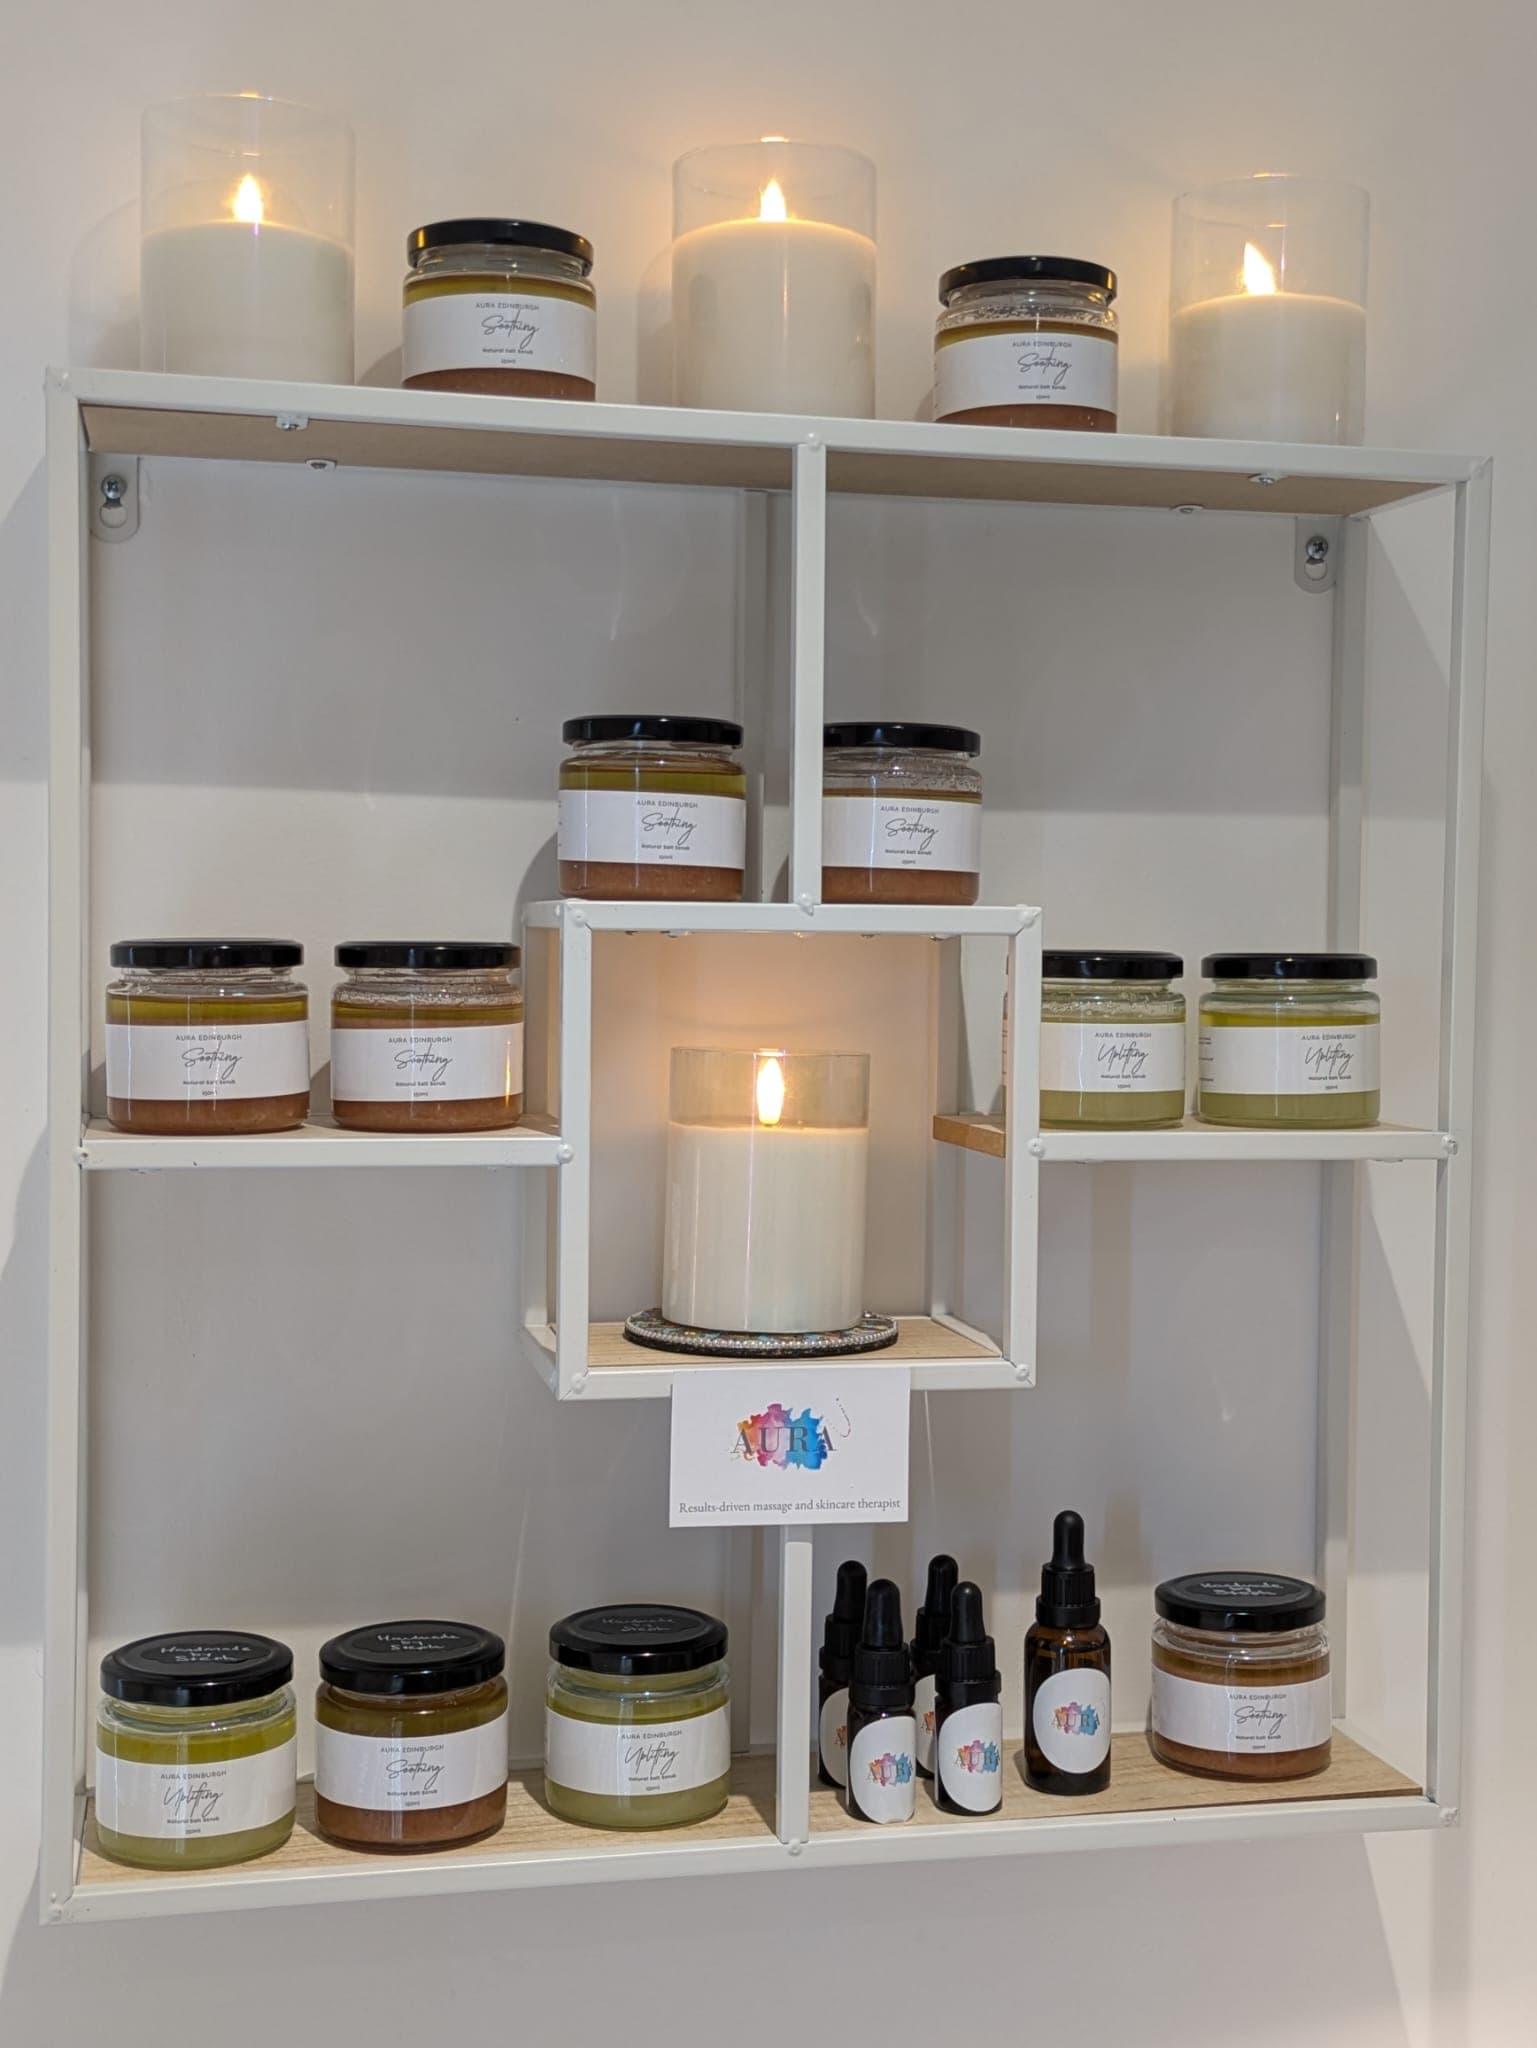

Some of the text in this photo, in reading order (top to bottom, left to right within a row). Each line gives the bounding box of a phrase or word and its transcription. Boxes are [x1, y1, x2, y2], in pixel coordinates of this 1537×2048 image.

[497, 302, 540, 311] EDINBURGH
[481, 309, 540, 350] Soothing
[1033, 340, 1072, 348] EDINBURGH
[1017, 347, 1072, 386] Soothing
[657, 800, 698, 809] EDINBURGH
[901, 806, 939, 814] EDINBURGH
[641, 807, 698, 846] Soothing
[885, 813, 940, 851] Soothing
[198, 1033, 242, 1041] EDINBURGH
[1322, 1033, 1356, 1041] EDINBURGH
[181, 1039, 243, 1081] Soothing
[394, 1041, 453, 1082] Soothing
[1097, 1040, 1150, 1075] Uplifting
[1304, 1042, 1354, 1076] Uplifting
[731, 1426, 837, 1454] AURA
[679, 1497, 901, 1514] Results-driven massage and skincare therapist
[1249, 1693, 1287, 1701] EDINBURGH
[1050, 1711, 1101, 1729] AURA
[1234, 1699, 1288, 1736] Soothing
[642, 1727, 682, 1740] EDINBURGH
[402, 1744, 445, 1753] EDINBURGH
[624, 1740, 680, 1777] Uplifting
[182, 1769, 227, 1780] EDINBURGH
[386, 1751, 445, 1791] Soothing
[163, 1781, 224, 1818] Uplifting
